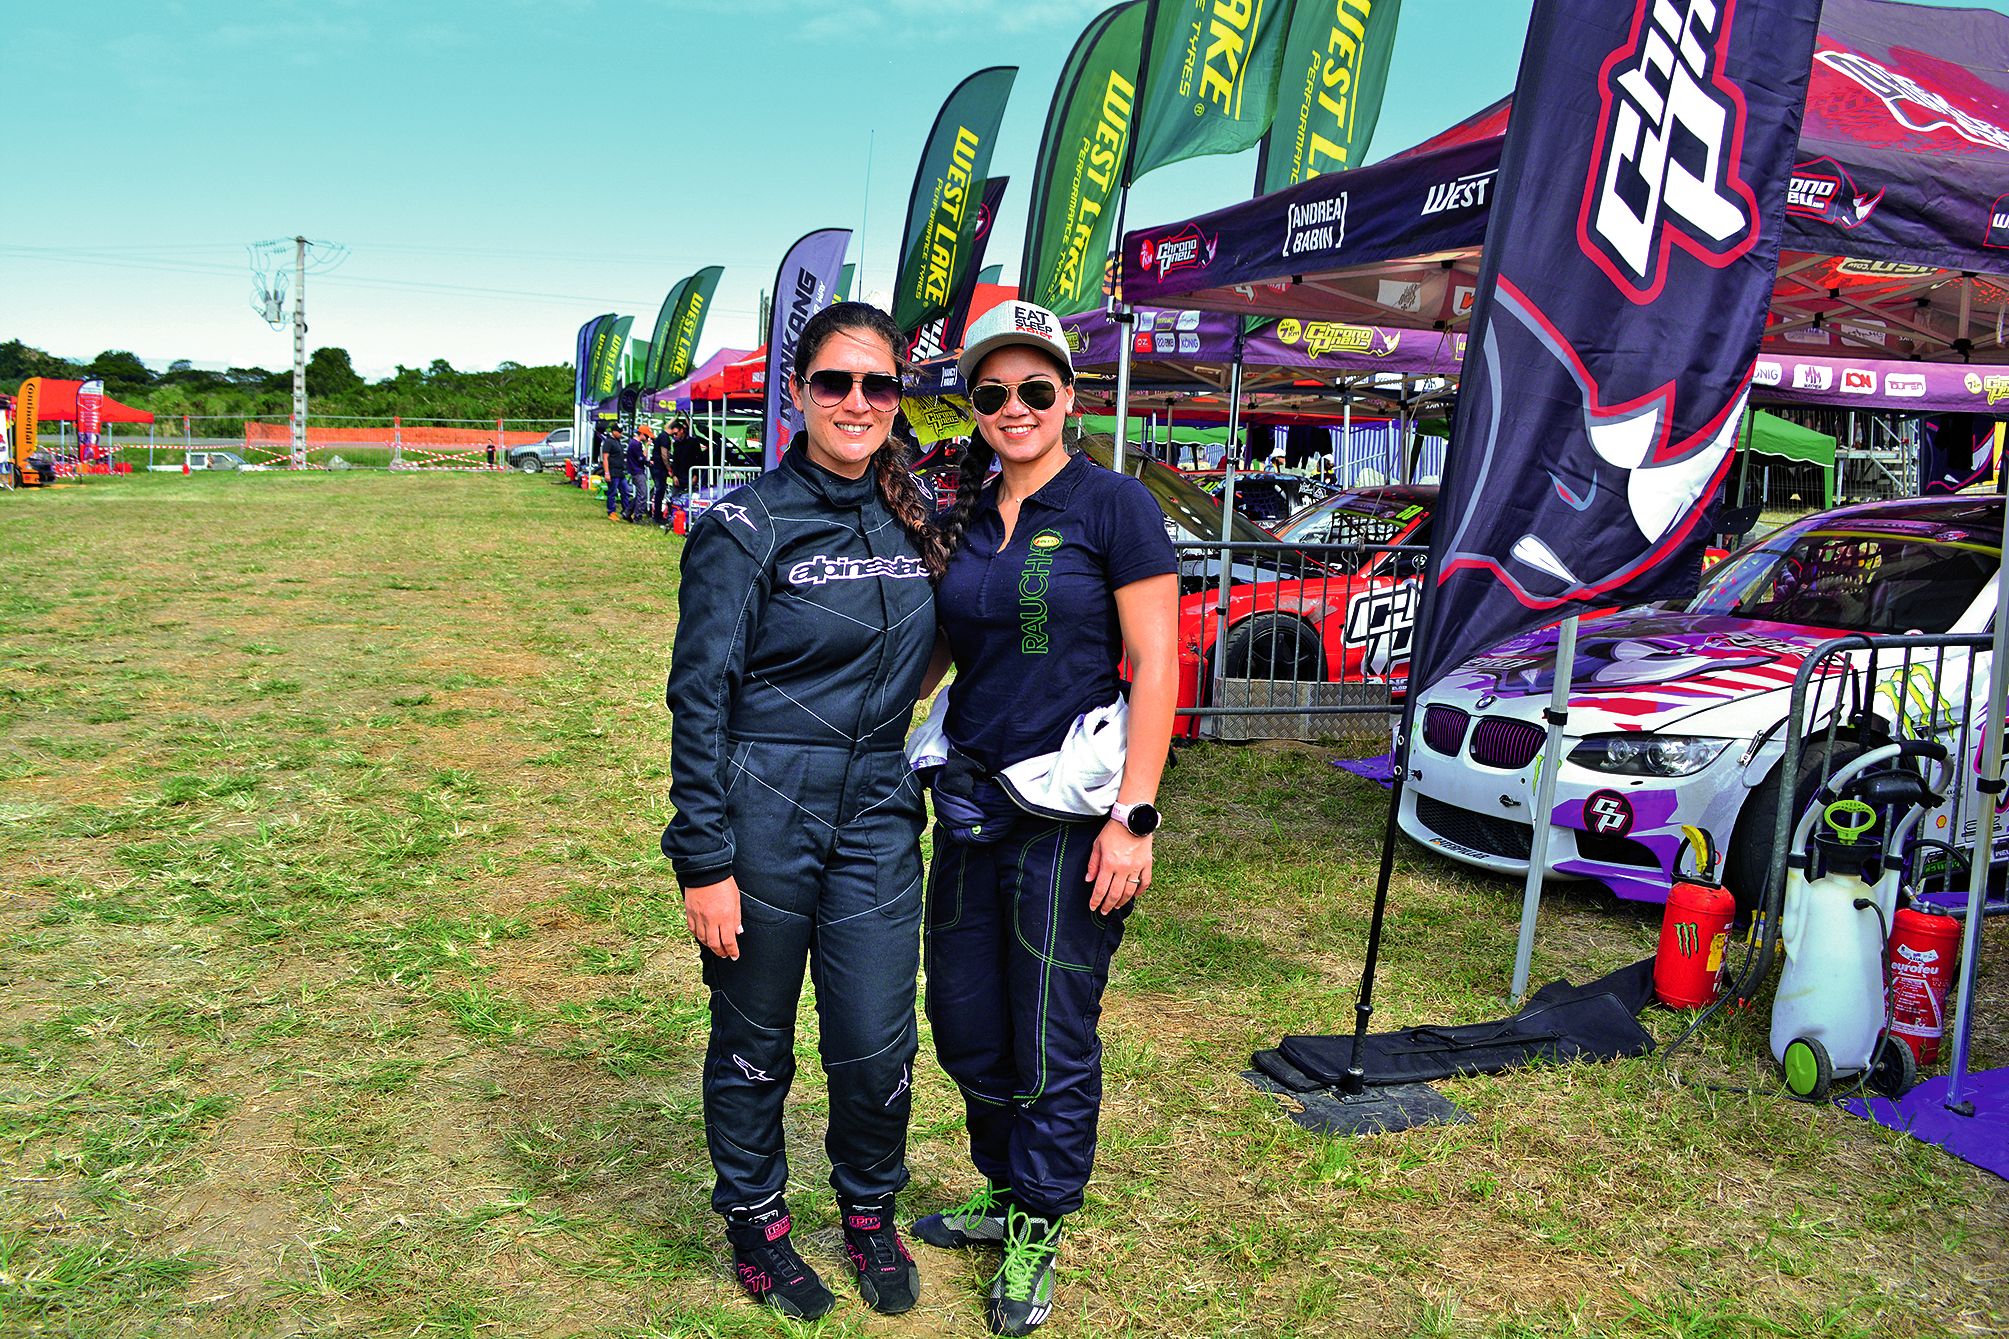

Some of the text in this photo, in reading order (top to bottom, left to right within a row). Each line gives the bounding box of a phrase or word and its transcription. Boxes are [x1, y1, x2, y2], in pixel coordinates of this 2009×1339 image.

[1179, 21, 1201, 98] TYRES
[1087, 70, 1135, 193] WEST
[941, 125, 980, 222] WEST
[1062, 137, 1091, 245] PERFORMANCE
[1292, 198, 1341, 227] ANDREA
[1421, 177, 1490, 216] WEST
[922, 177, 943, 261] PERFORMANCE
[1292, 226, 1334, 252] BABIN
[915, 263, 927, 300] TYRES
[924, 223, 957, 306] LAKE
[683, 292, 704, 334] WEST
[1015, 306, 1049, 325] EAT
[1015, 319, 1052, 333] SLEEP
[1306, 324, 1371, 339] Chrono
[674, 337, 691, 376] LAKE
[779, 266, 817, 423] NANKANG
[26, 383, 36, 444] Continental
[1891, 962, 1939, 974] eurofeu
[767, 1218, 789, 1234] rpm
